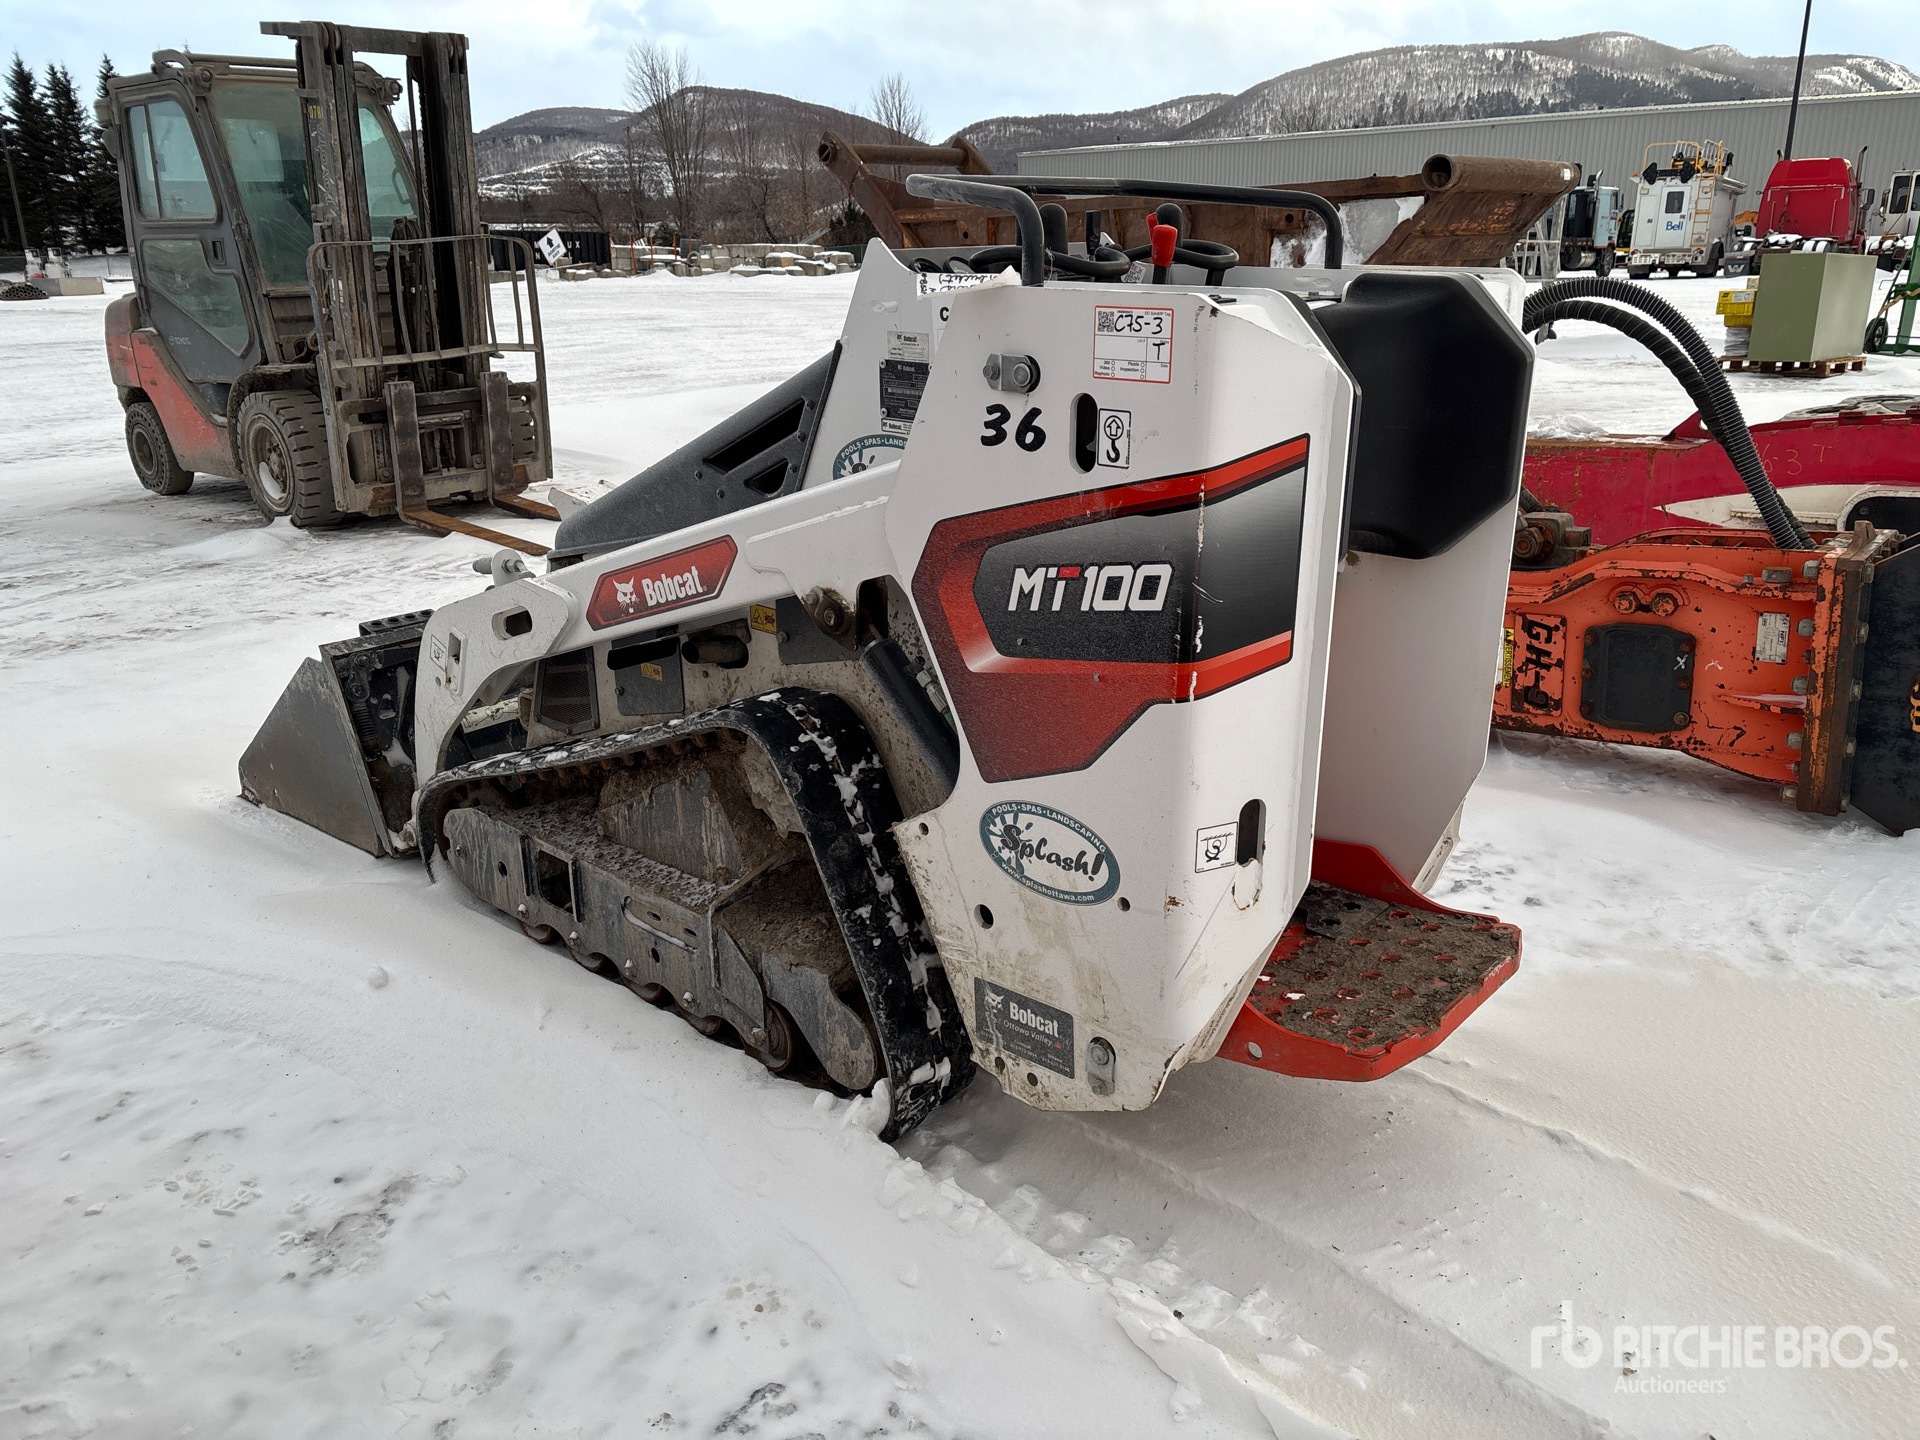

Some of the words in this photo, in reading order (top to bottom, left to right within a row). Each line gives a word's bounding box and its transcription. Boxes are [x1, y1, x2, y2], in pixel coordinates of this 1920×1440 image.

[1666, 221, 1684, 231] Bell
[1114, 314, 1163, 335] C75-3
[1152, 342, 1166, 361] T
[980, 403, 1046, 452] 36
[840, 442, 862, 459] POOLS
[863, 437, 881, 447] SPAS
[641, 565, 703, 607] Bobcat
[1008, 563, 1173, 611] MT100
[991, 803, 1017, 815] POOLS
[1021, 803, 1043, 814] SPAS
[1046, 809, 1107, 853] LANDSCAPING
[1001, 862, 1095, 902] www.splashottawa.com
[1003, 1019, 1030, 1036] Ottawa
[1030, 1030, 1053, 1047] Valley
[1009, 1001, 1059, 1038] Bobcat
